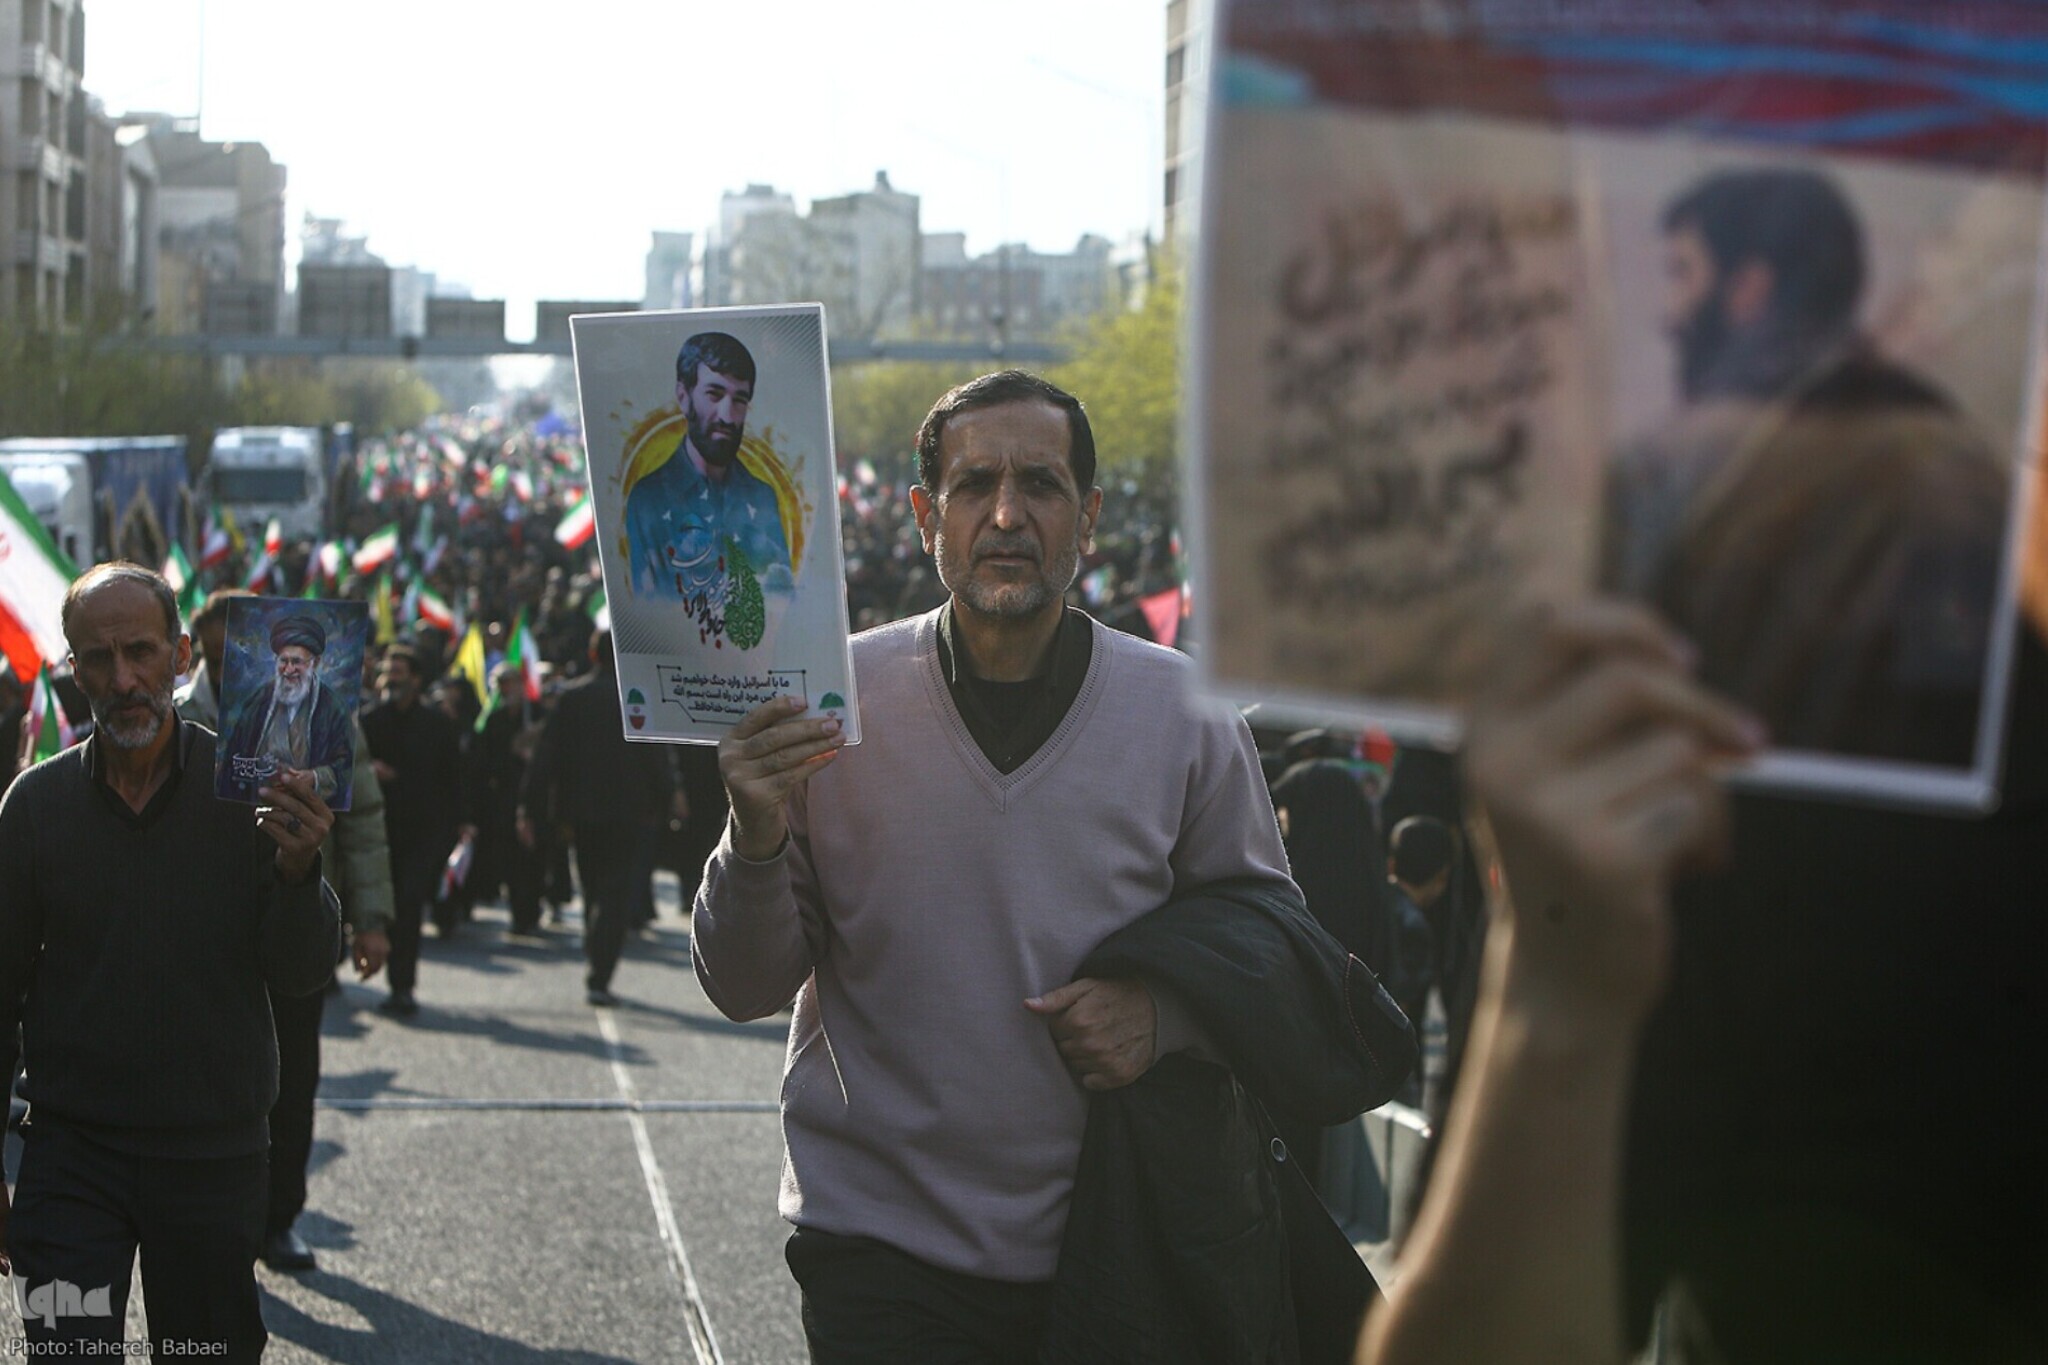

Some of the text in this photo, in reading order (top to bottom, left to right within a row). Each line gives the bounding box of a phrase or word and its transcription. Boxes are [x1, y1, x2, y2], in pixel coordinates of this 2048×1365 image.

[671, 673, 683, 683] شد
[683, 674, 709, 687] خواهیم
[710, 673, 727, 686] جنگ
[727, 676, 741, 689] وارد
[772, 676, 779, 690] با
[779, 676, 790, 688] ما
[673, 684, 685, 696] الله
[686, 690, 704, 699] بسم
[705, 688, 722, 698] است
[723, 689, 732, 702] راه
[732, 690, 744, 703] این
[745, 692, 759, 703] مرد
[724, 705, 745, 715] نیست
